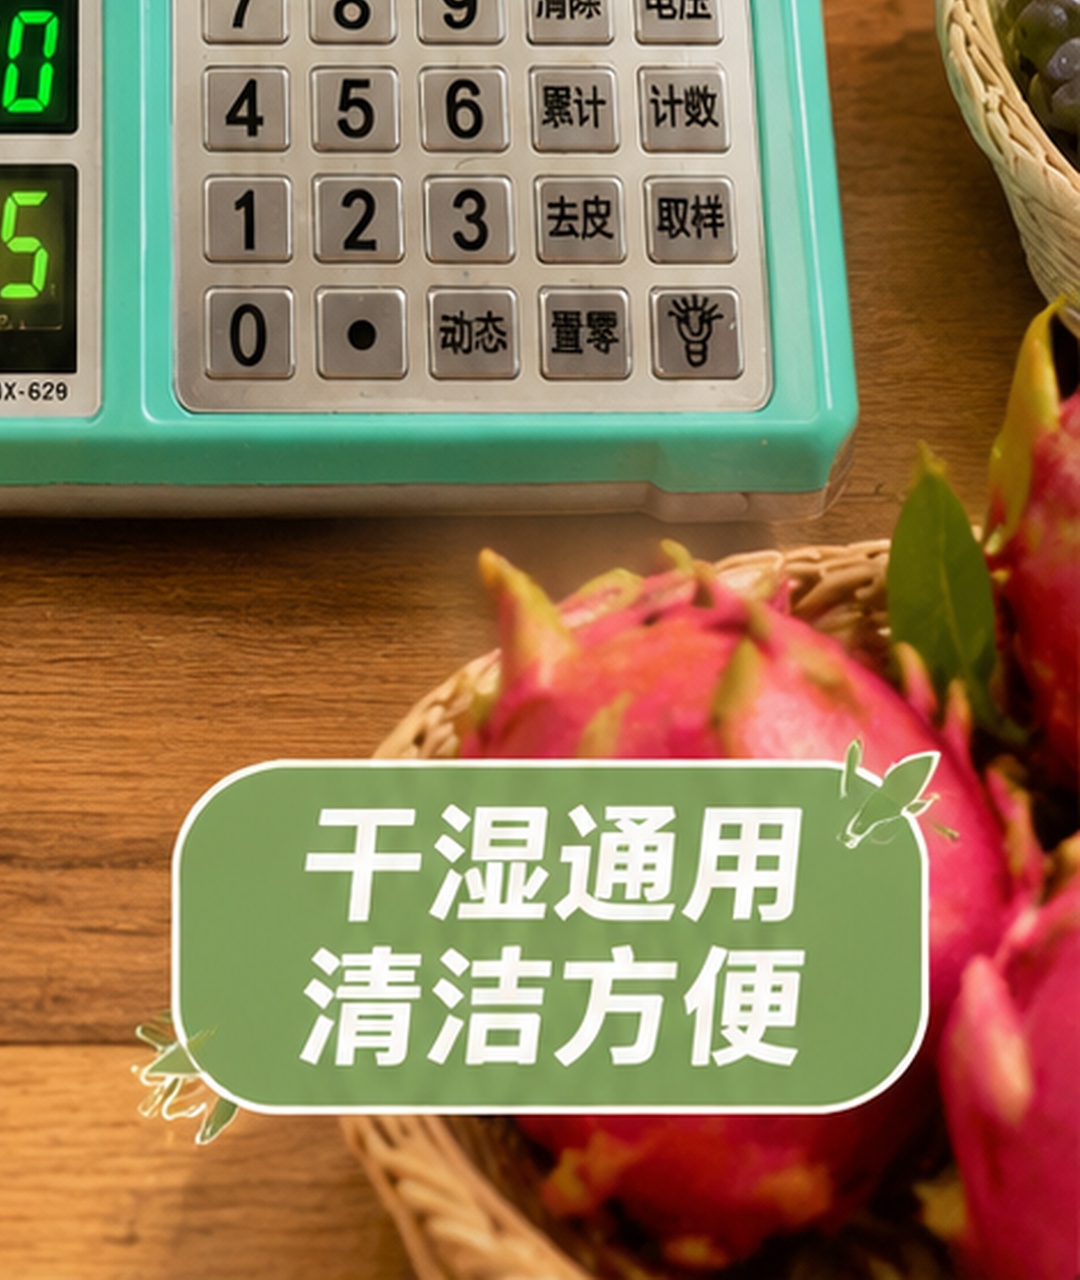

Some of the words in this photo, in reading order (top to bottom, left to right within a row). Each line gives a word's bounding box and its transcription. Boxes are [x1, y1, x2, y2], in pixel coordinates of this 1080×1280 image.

[224, 78, 265, 138] 4
[336, 78, 375, 139] 5
[445, 78, 484, 140] 6
[540, 84, 608, 130] 累计
[649, 83, 720, 129] 计数
[233, 188, 256, 251] 1
[340, 188, 378, 252] 2
[452, 188, 489, 252] 3
[545, 194, 615, 241] 去皮
[656, 194, 726, 240] 取样
[229, 302, 268, 368] 0
[438, 309, 509, 356] 动态
